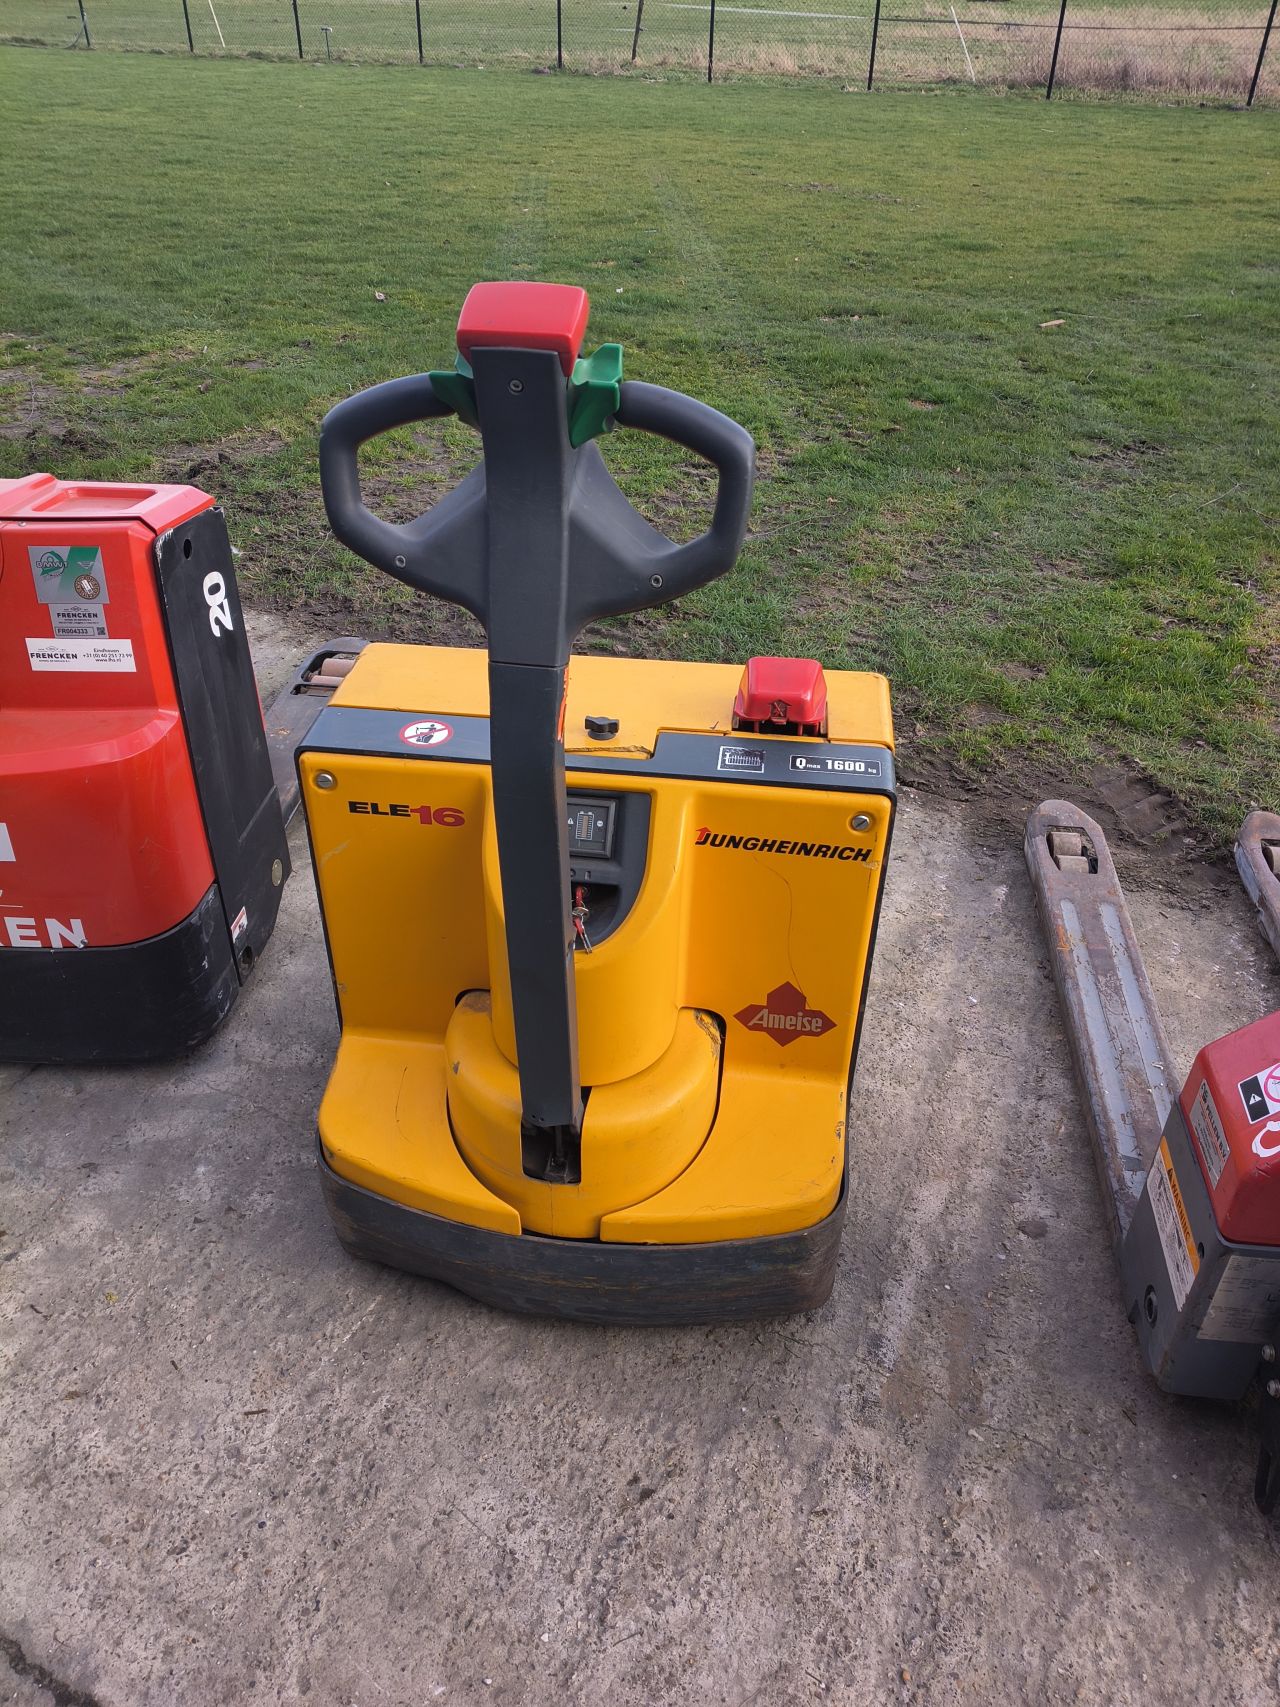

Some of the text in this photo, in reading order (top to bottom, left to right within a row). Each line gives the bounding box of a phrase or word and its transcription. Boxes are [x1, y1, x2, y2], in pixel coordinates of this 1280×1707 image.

[202, 570, 234, 638] 20
[30, 652, 78, 660] FRENCKEN
[825, 759, 865, 772] 1600
[695, 829, 872, 862] JUNGHEINRICH
[0, 916, 87, 949] EN
[747, 1008, 823, 1033] Ameise
